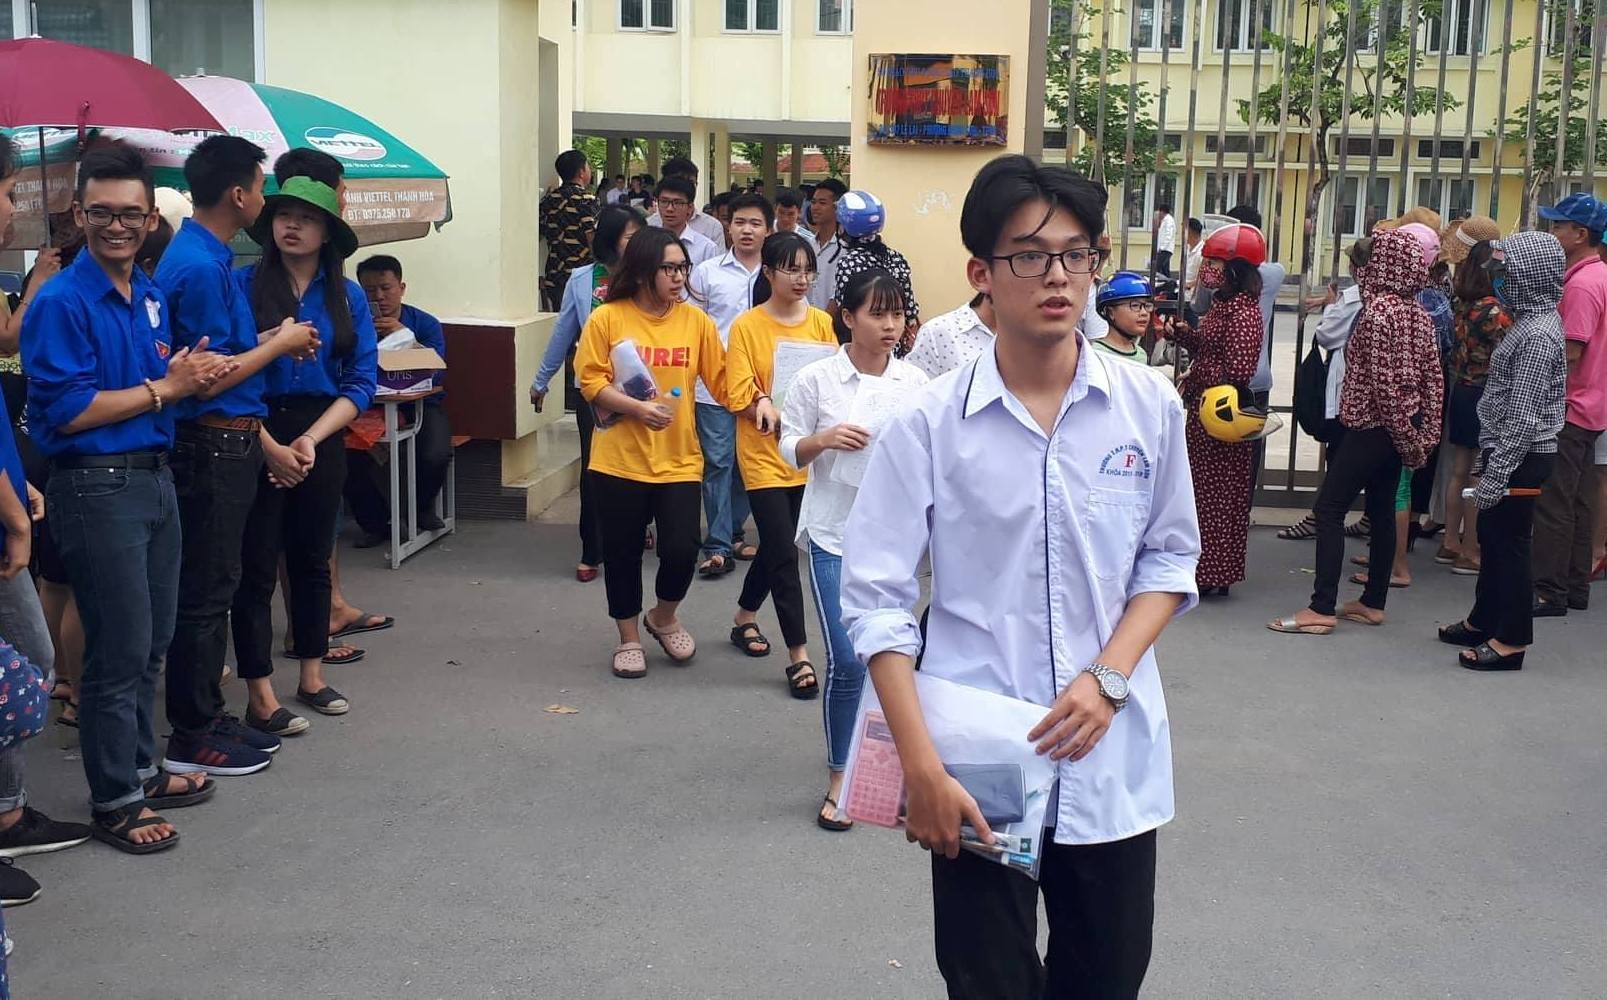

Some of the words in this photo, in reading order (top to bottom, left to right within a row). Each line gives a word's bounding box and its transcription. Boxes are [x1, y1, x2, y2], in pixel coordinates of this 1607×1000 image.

[308, 139, 382, 149] VIETTEL
[363, 190, 393, 203] VIETTEL
[394, 190, 418, 203] THANH
[1124, 454, 1137, 468] F
